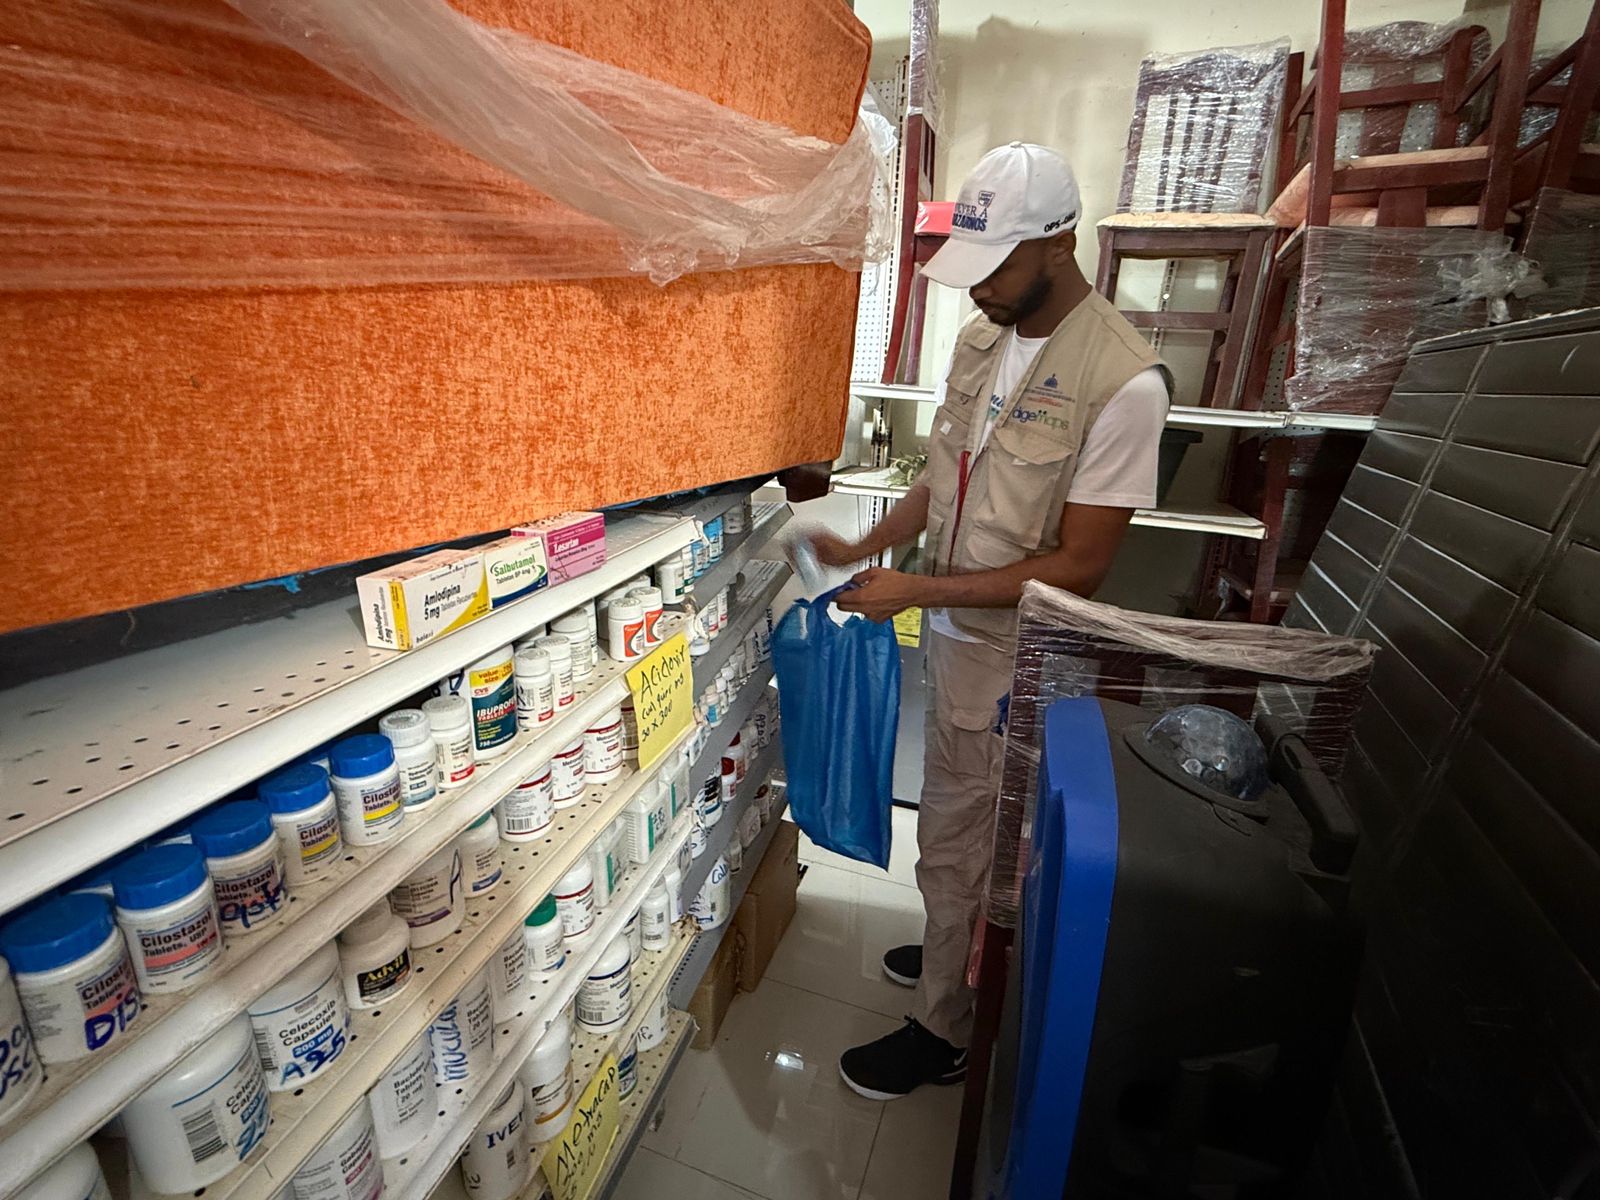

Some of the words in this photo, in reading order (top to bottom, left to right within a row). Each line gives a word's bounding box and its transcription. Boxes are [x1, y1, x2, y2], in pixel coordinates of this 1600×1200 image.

[494, 554, 536, 577] Salbutamol
[424, 583, 461, 607] Amlodipina
[373, 603, 385, 642] Amlodipina
[424, 609, 430, 620] 5
[430, 604, 440, 619] mg
[478, 670, 499, 679] value
[484, 676, 499, 684] size
[141, 910, 212, 949] Cilostazol
[144, 941, 187, 958] Tablets,
[189, 927, 208, 943] USP
[365, 954, 403, 982] Advil
[278, 1000, 336, 1038] Celecoxib
[282, 1009, 336, 1047] Capsules
[294, 1041, 316, 1056] 200
